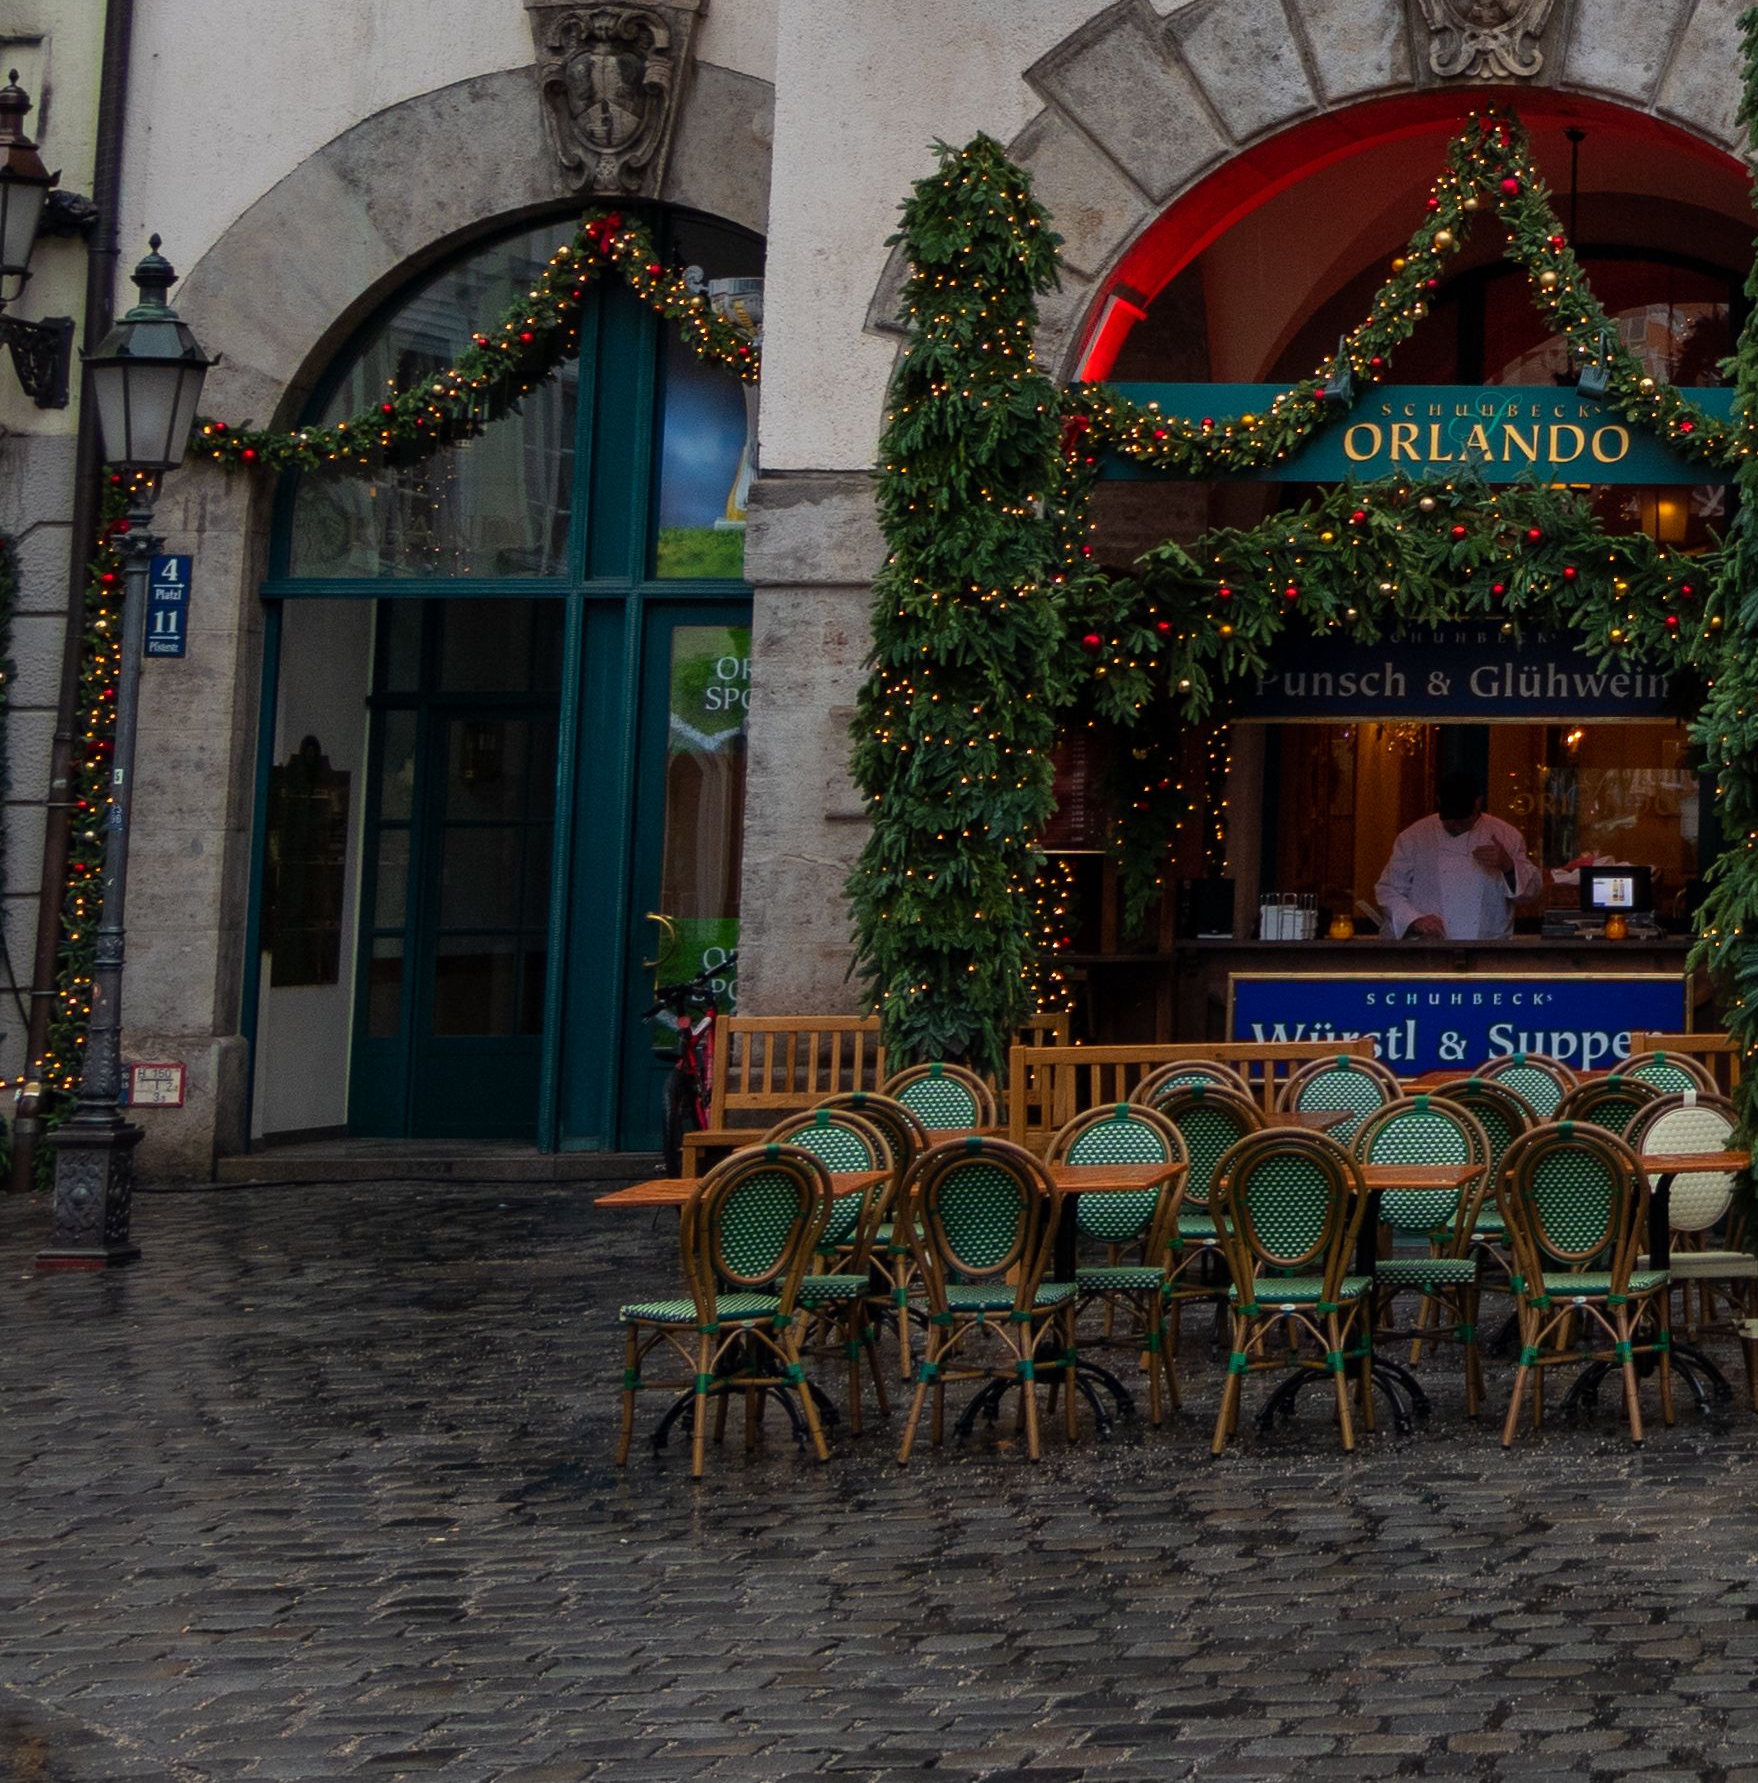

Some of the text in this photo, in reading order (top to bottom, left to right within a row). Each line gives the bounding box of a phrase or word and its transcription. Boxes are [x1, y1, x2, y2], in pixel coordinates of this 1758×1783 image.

[1344, 423, 1629, 463] ORLANDO
[161, 558, 178, 581] 4
[153, 610, 178, 633] 11
[1256, 662, 1669, 698] Punsch & Glühwein
[1439, 1031, 1467, 1060] &
[1489, 1022, 1663, 1072] Suppe
